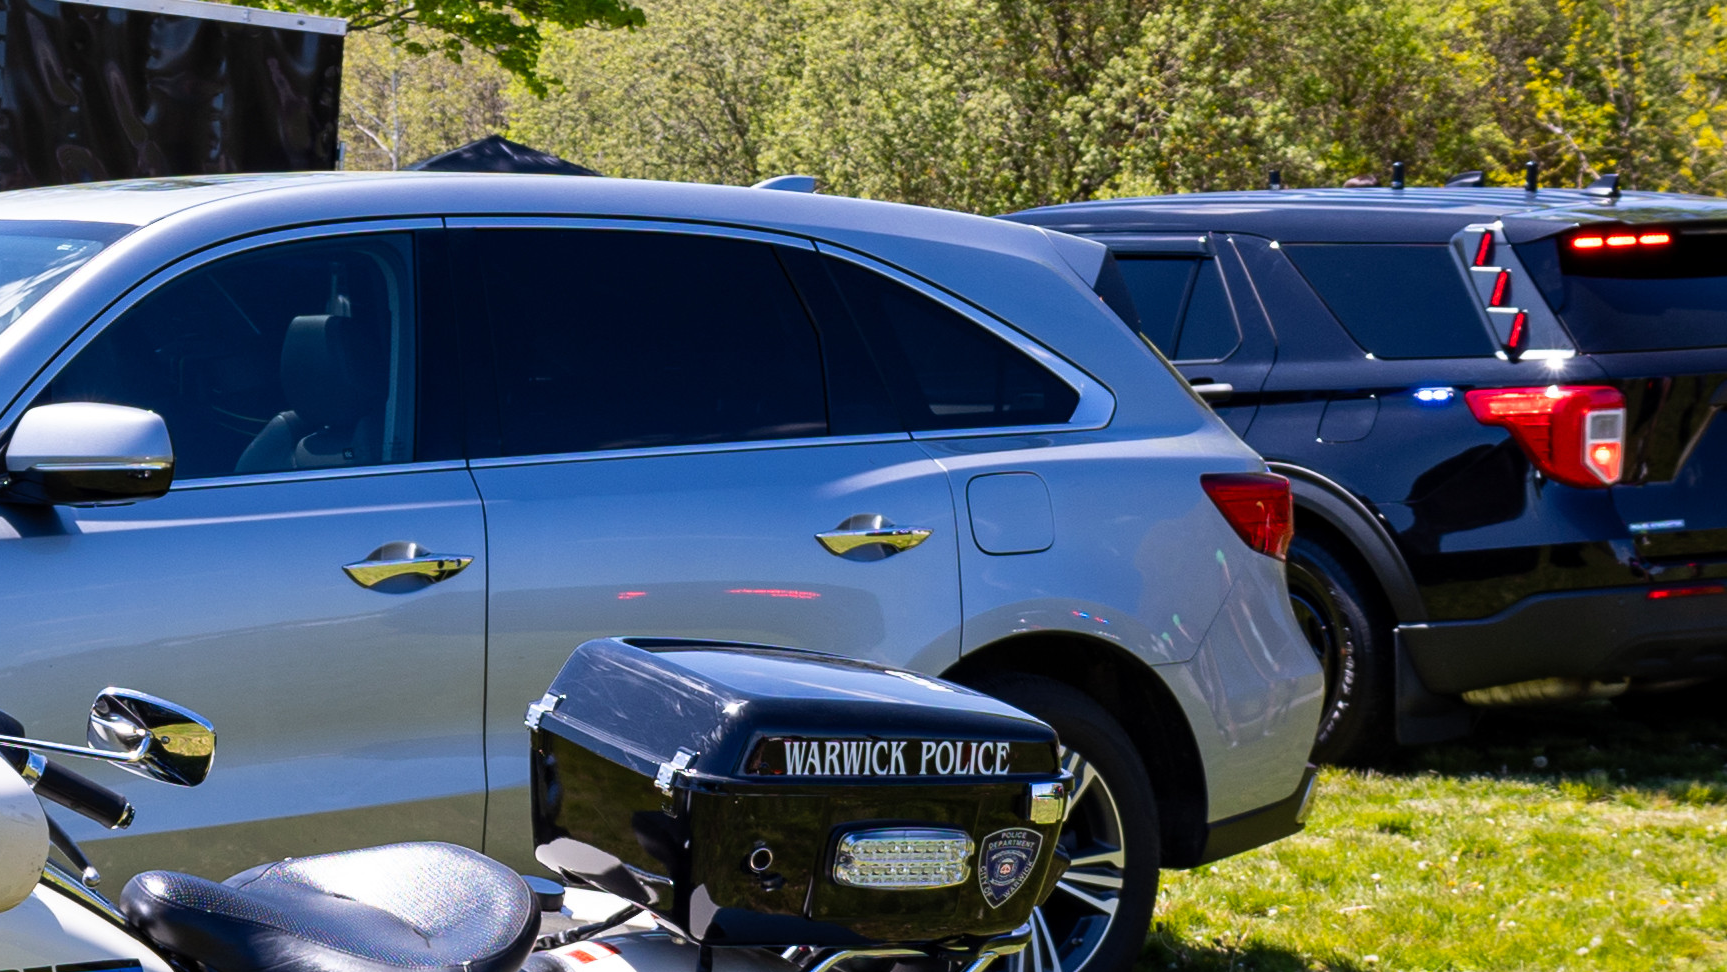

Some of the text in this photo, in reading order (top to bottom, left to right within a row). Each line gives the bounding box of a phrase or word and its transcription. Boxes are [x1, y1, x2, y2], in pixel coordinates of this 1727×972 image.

[785, 740, 1010, 776] WARWICK POLICE
[988, 840, 1035, 850] DEPARTMENT
[1001, 831, 1028, 839] POLICE
[979, 865, 993, 897] CITY OF
[1003, 861, 1033, 898] WARWICK
